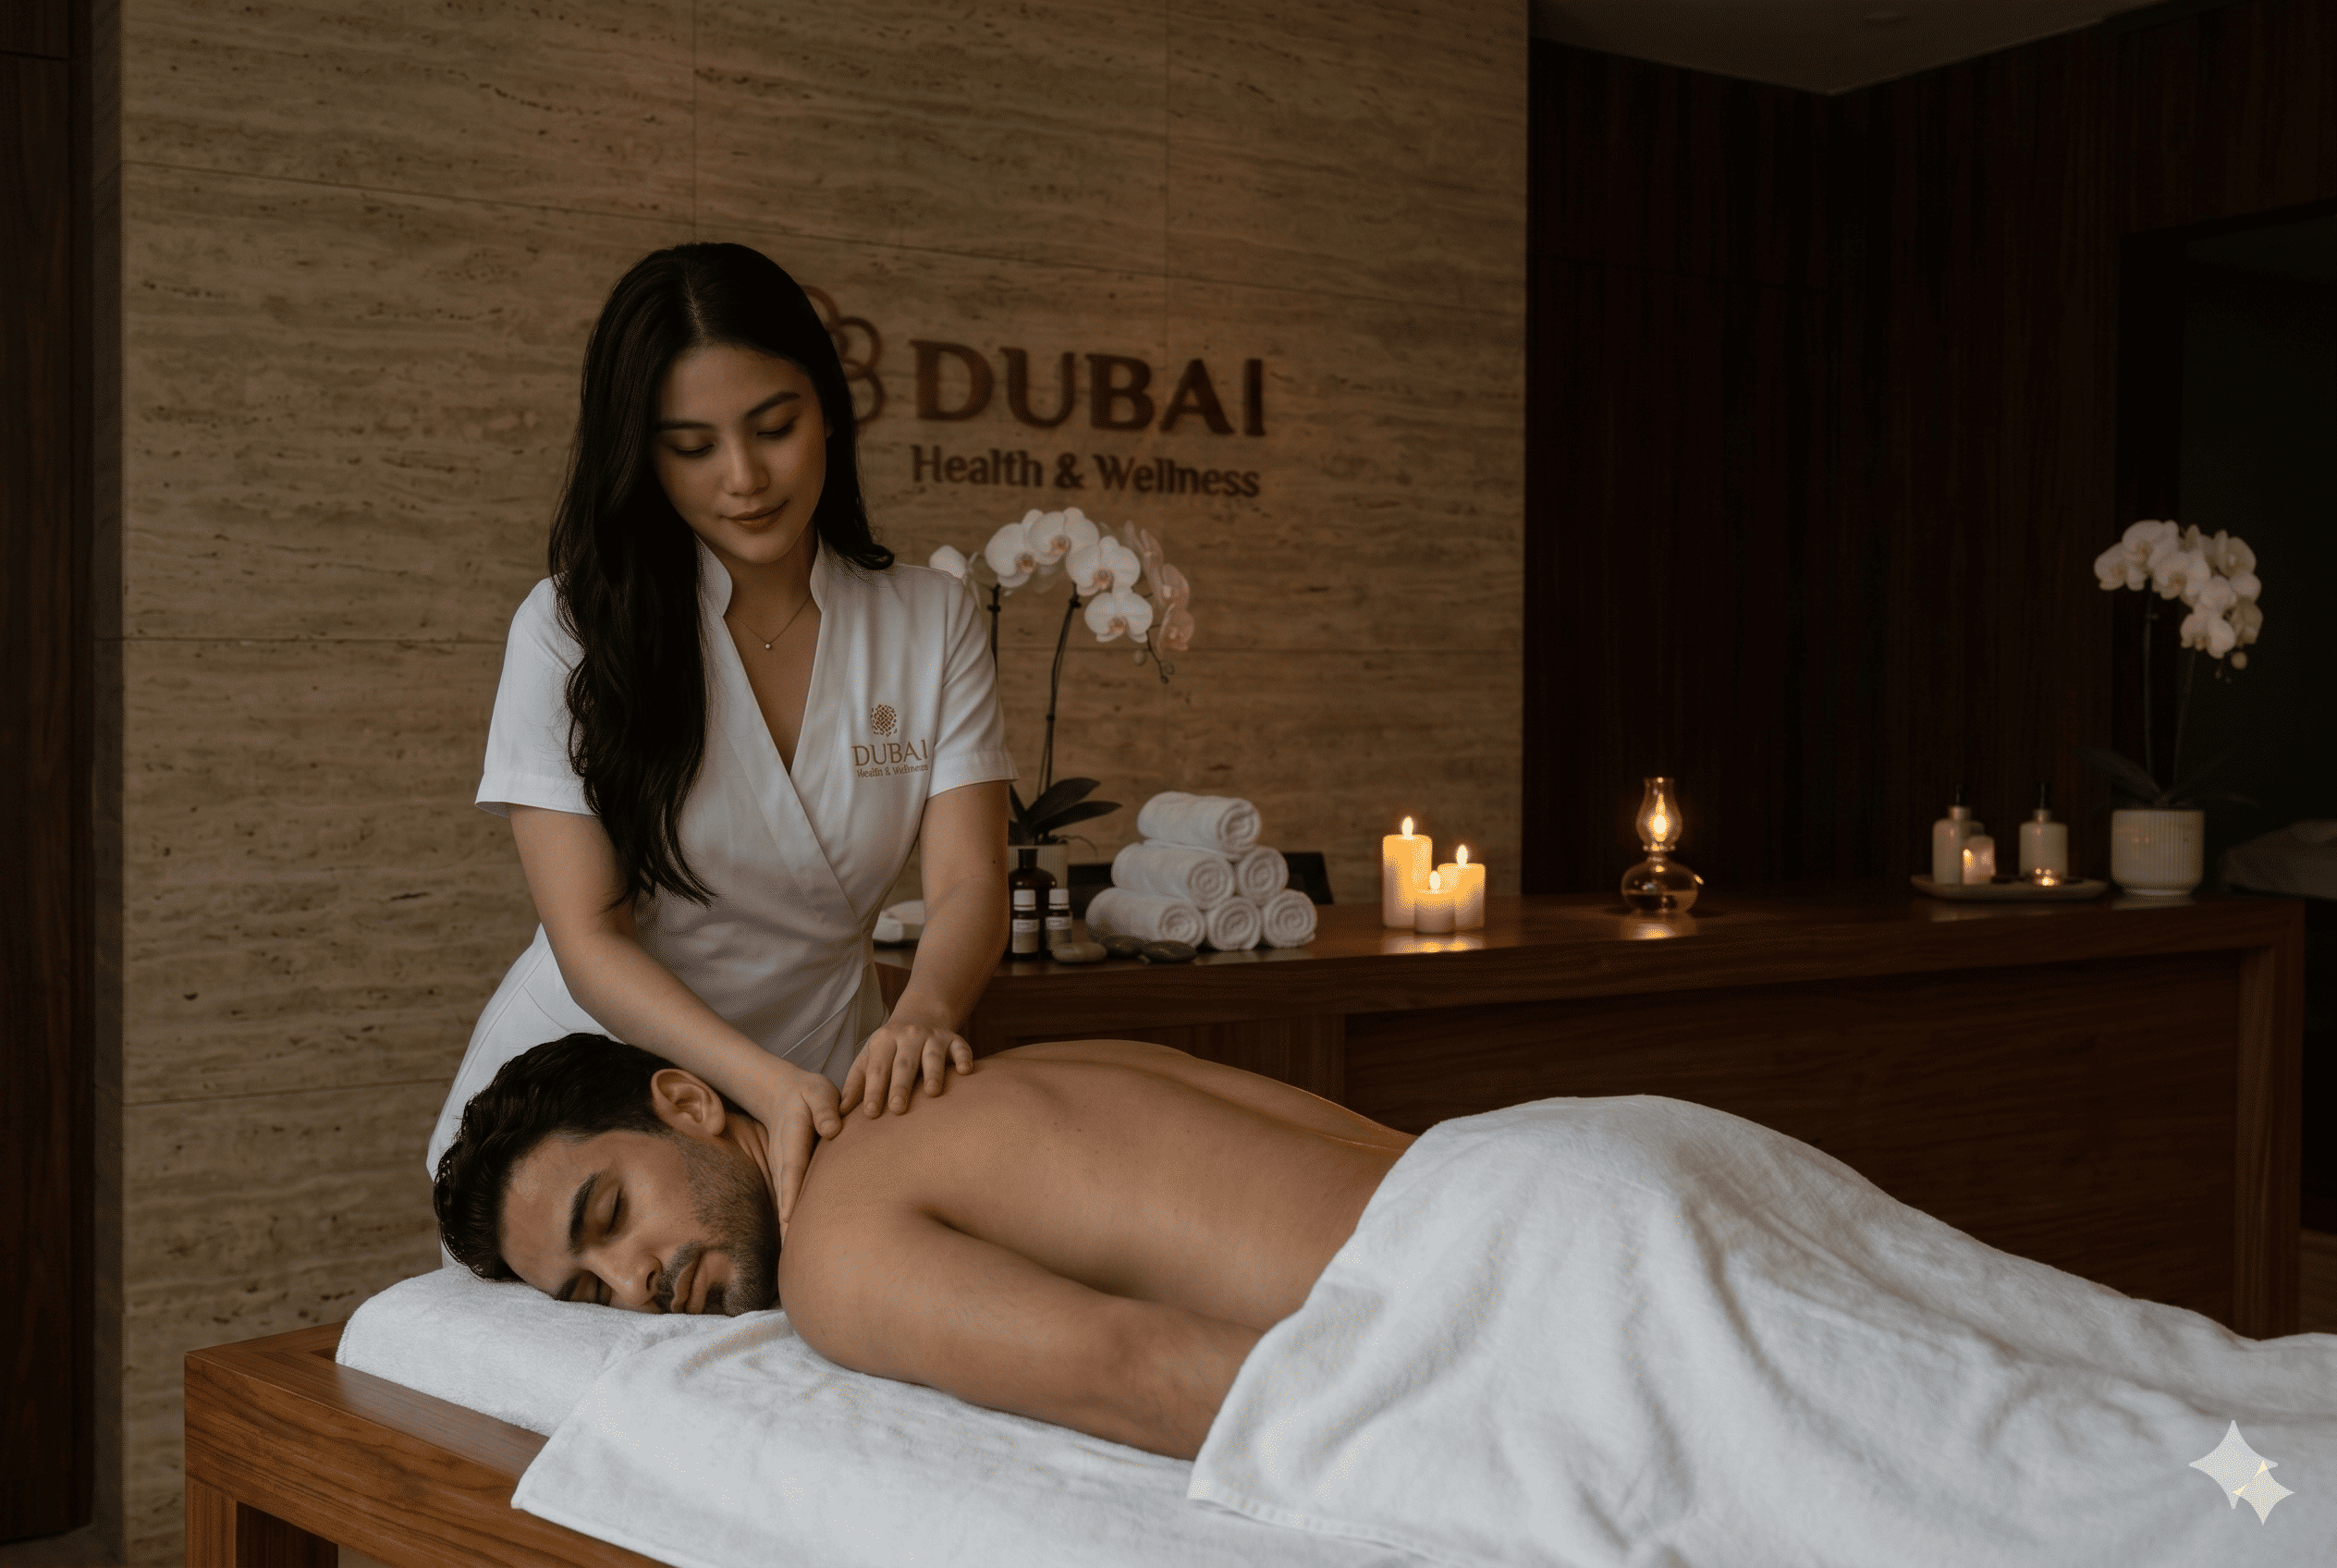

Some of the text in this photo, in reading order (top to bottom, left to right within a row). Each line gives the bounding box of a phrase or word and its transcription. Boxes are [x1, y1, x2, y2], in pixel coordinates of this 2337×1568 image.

[909, 339, 1266, 436] DUBAI
[911, 445, 1260, 497] Health & Wellness
[851, 740, 928, 766] DUBAI
